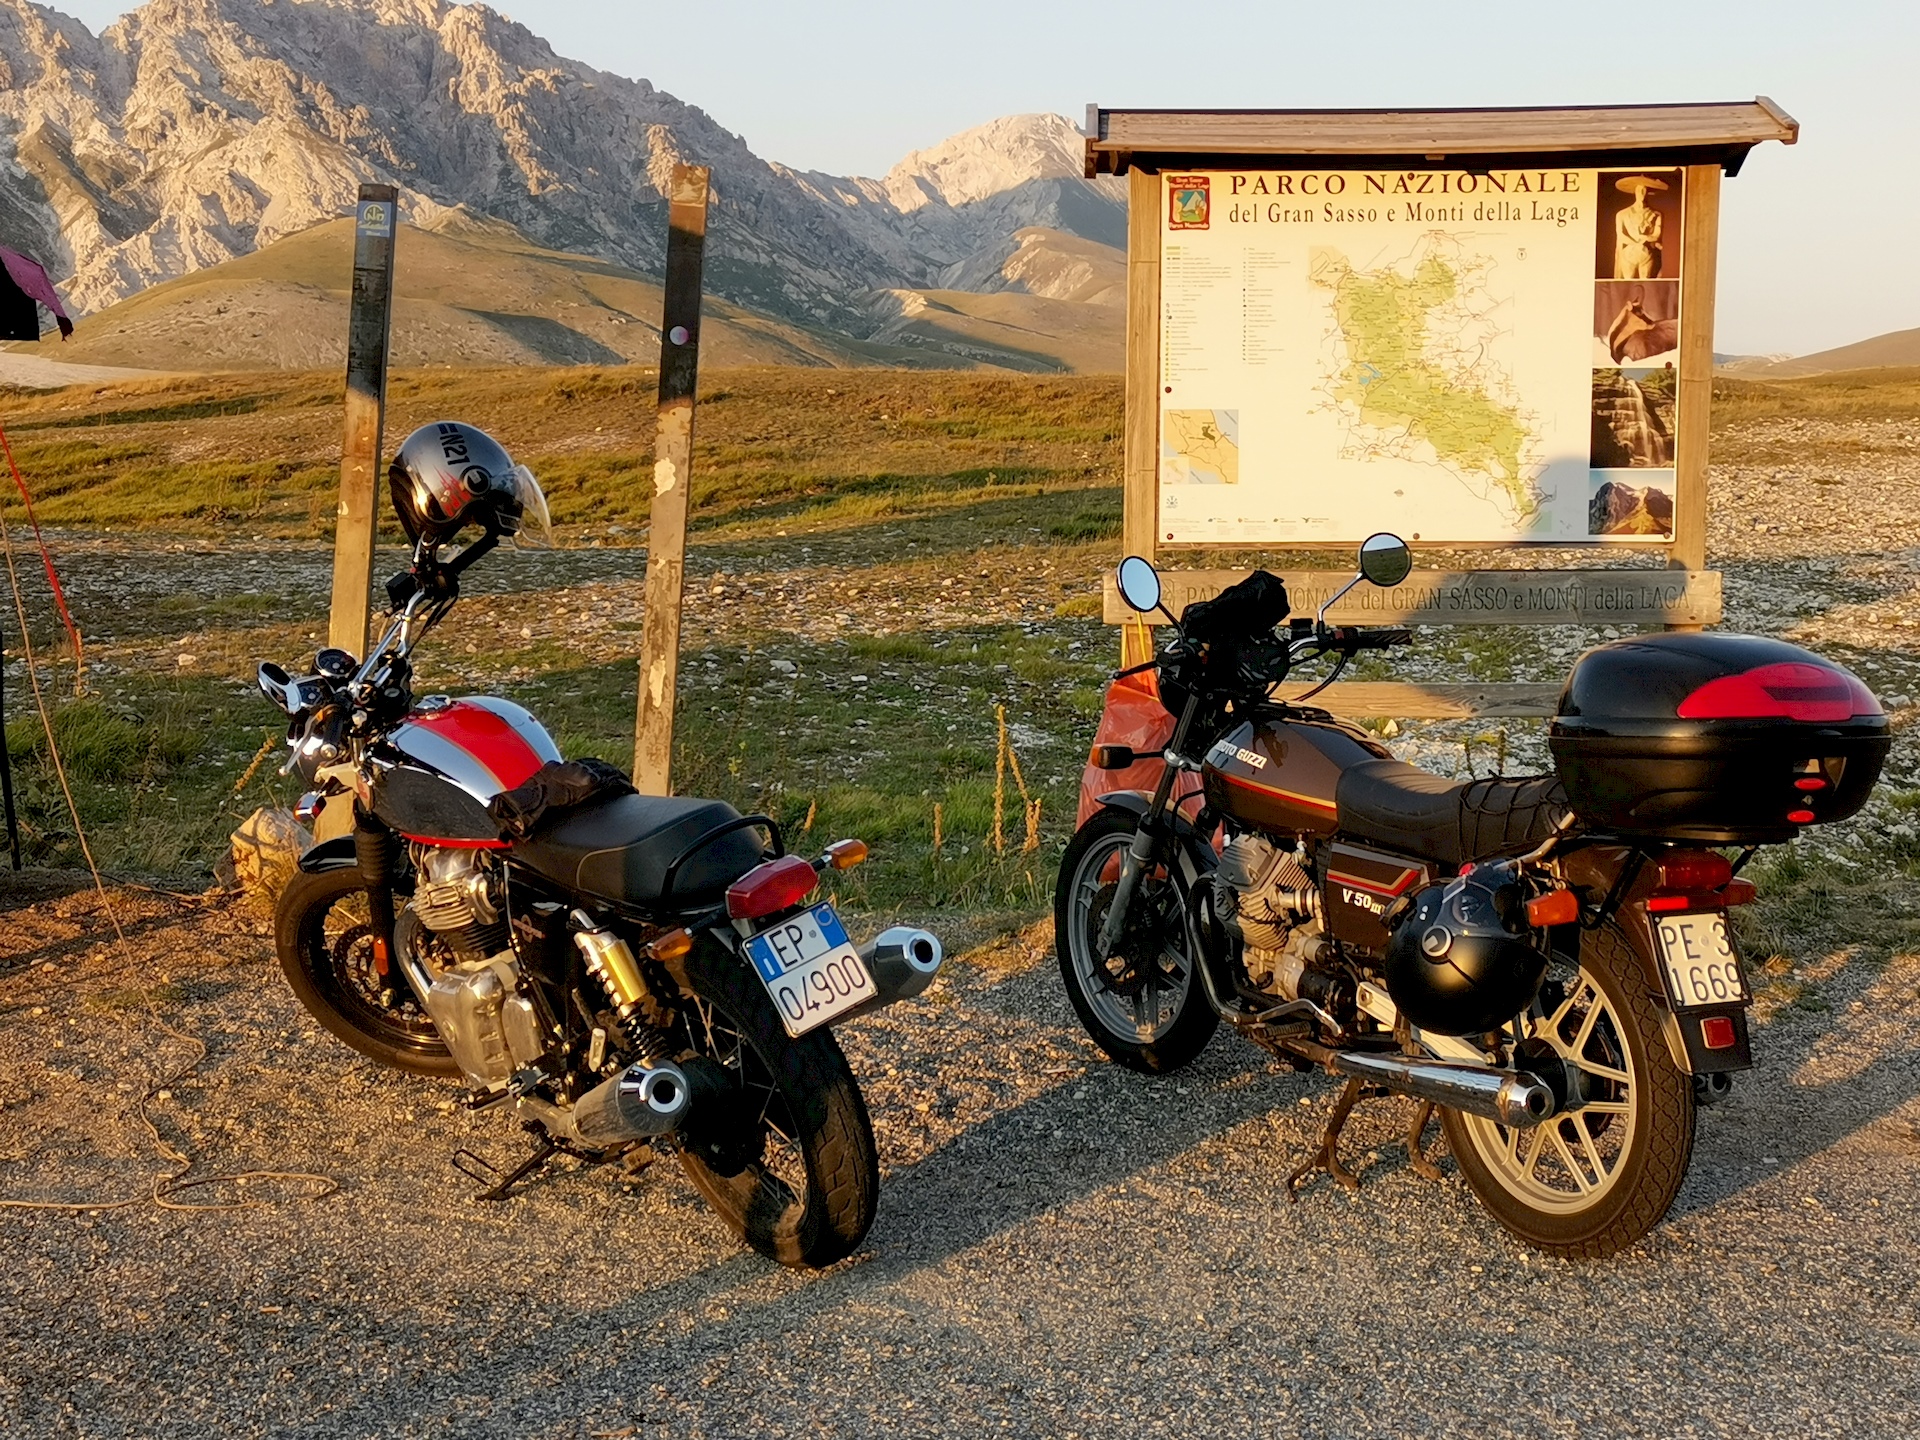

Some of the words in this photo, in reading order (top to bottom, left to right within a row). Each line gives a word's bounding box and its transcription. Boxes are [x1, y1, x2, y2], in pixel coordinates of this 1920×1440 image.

[1230, 174, 1346, 195] PARCO
[1363, 172, 1580, 195] NAZIONALE
[1229, 203, 1258, 223] del
[1268, 202, 1314, 223] Gran
[1324, 202, 1377, 223] Sasso
[1387, 208, 1395, 222] e
[1405, 201, 1463, 222] Monti
[1473, 201, 1521, 221] della
[1531, 201, 1579, 228] Laga
[1361, 588, 1385, 610] del
[1391, 587, 1441, 610] GRAN
[1450, 587, 1508, 611] SASSO
[1514, 594, 1523, 610] e
[1528, 587, 1588, 610] MONTI
[1594, 587, 1634, 610] della
[1640, 586, 1690, 610] LAGA
[1236, 748, 1268, 769] GUZZI
[768, 923, 805, 968] EP
[1660, 924, 1701, 962] PE
[1712, 921, 1732, 957] 3
[779, 955, 866, 1021] 04900
[1671, 962, 1743, 1002] 1669
